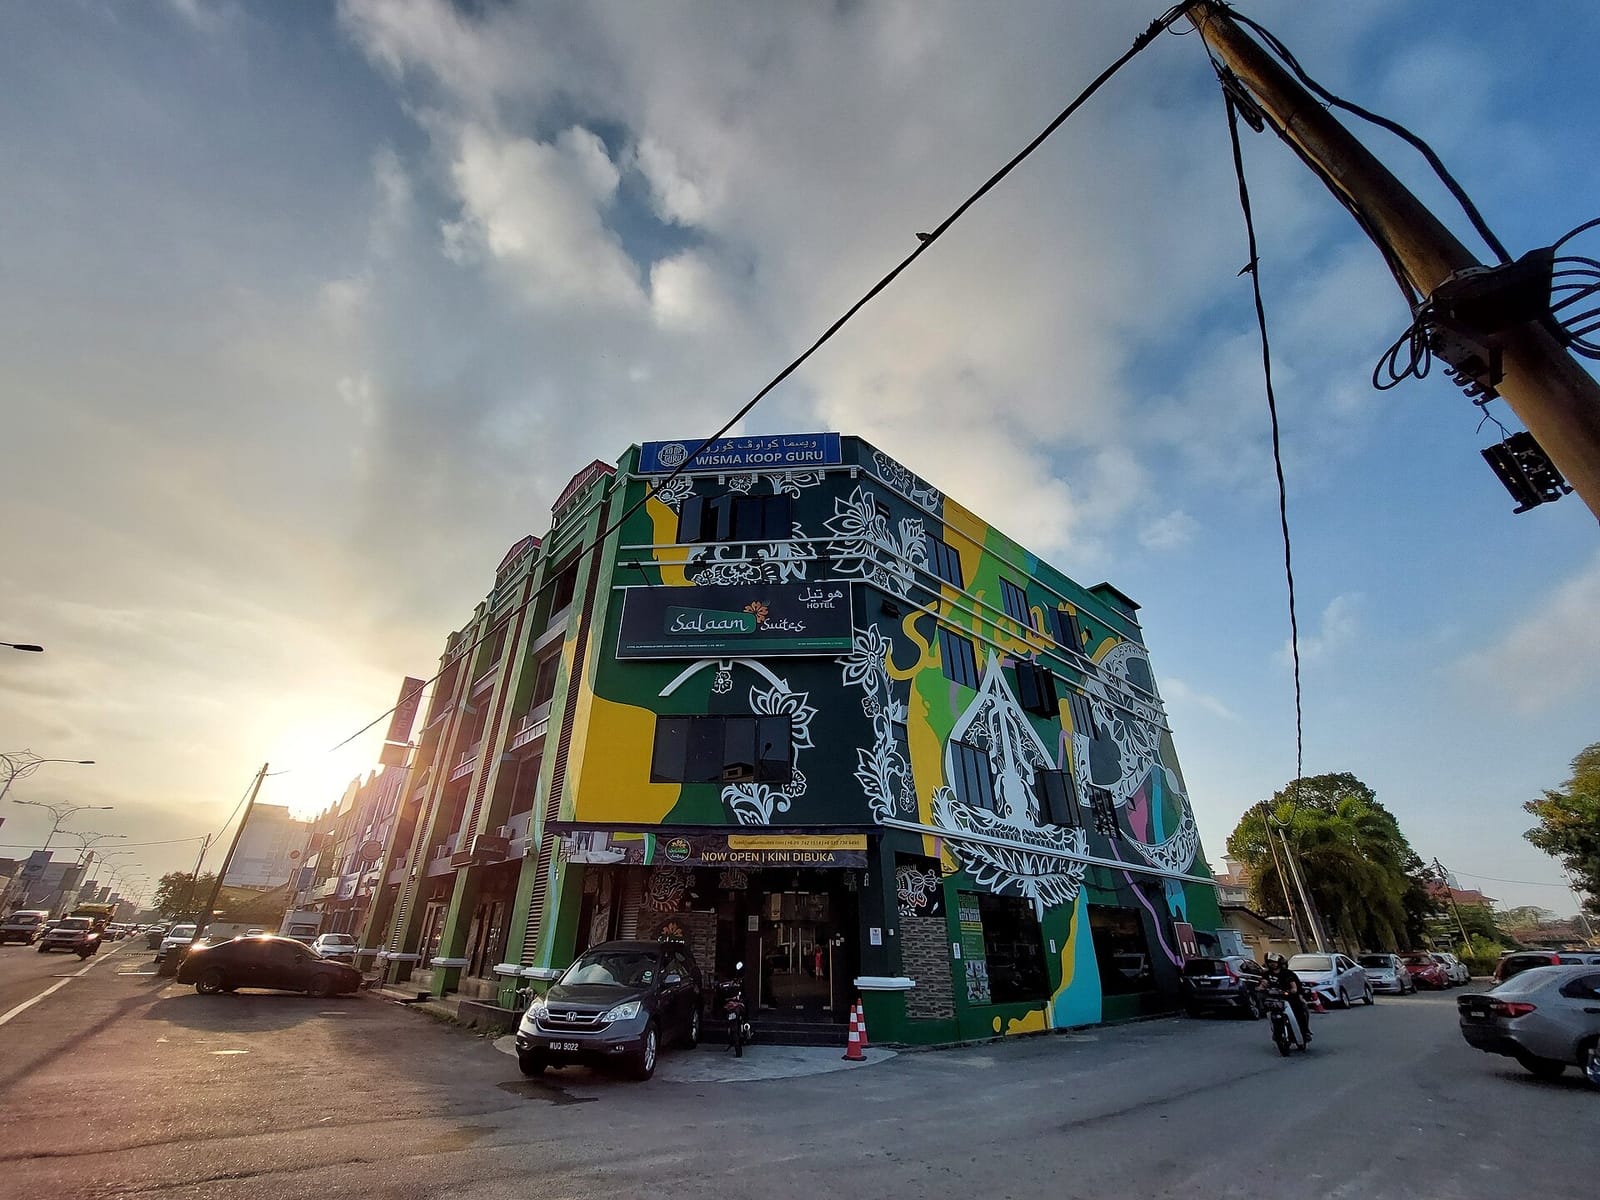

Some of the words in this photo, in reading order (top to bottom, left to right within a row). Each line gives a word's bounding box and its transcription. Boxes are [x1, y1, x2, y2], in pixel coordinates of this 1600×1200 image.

[695, 453, 742, 466] WISMA
[745, 452, 783, 464] KOOP
[785, 450, 823, 462] GURU
[806, 601, 836, 609] HOTEL
[670, 612, 750, 633] Salaam
[760, 618, 807, 632] Suites
[701, 852, 729, 862] NOW
[730, 852, 760, 862] OPEN
[767, 852, 791, 862] KINI
[793, 852, 835, 862] DIBUKA
[563, 1042, 579, 1051] 9022
